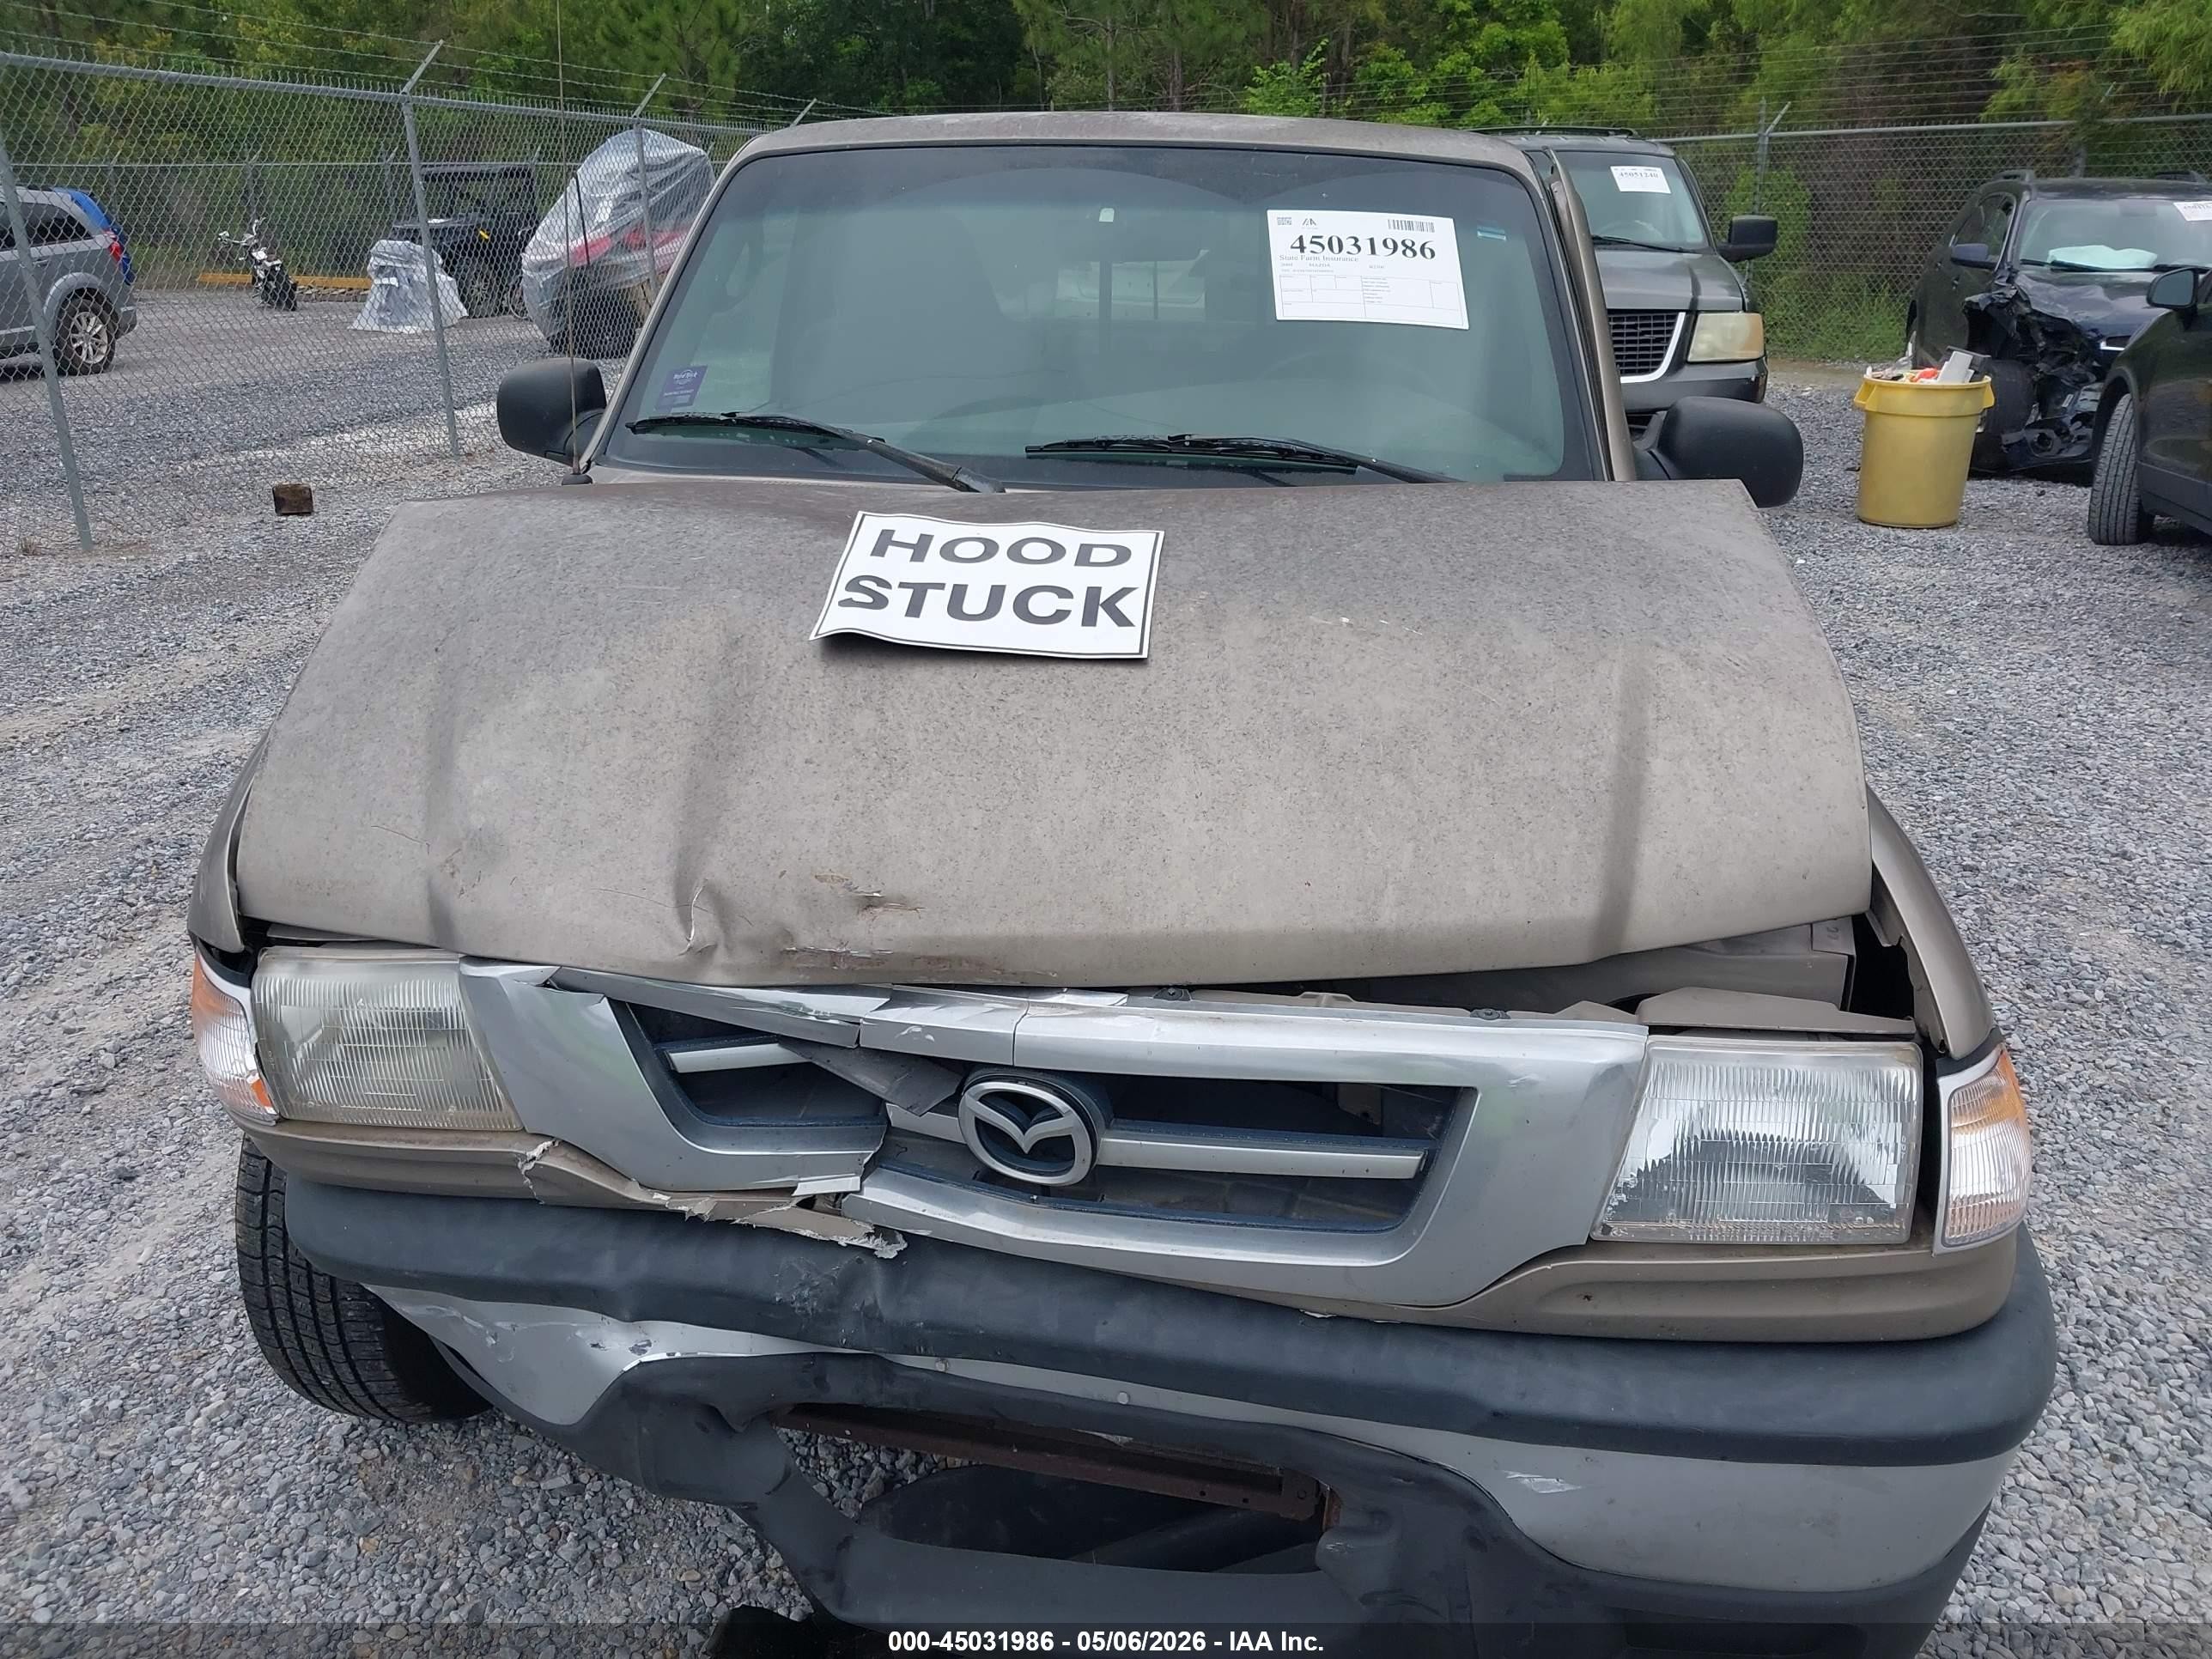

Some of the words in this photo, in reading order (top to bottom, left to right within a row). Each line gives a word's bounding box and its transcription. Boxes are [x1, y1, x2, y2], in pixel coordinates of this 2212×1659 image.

[1290, 234, 1437, 260] 45031986
[870, 528, 1132, 568] HOOD
[837, 574, 1139, 628] STUCK
